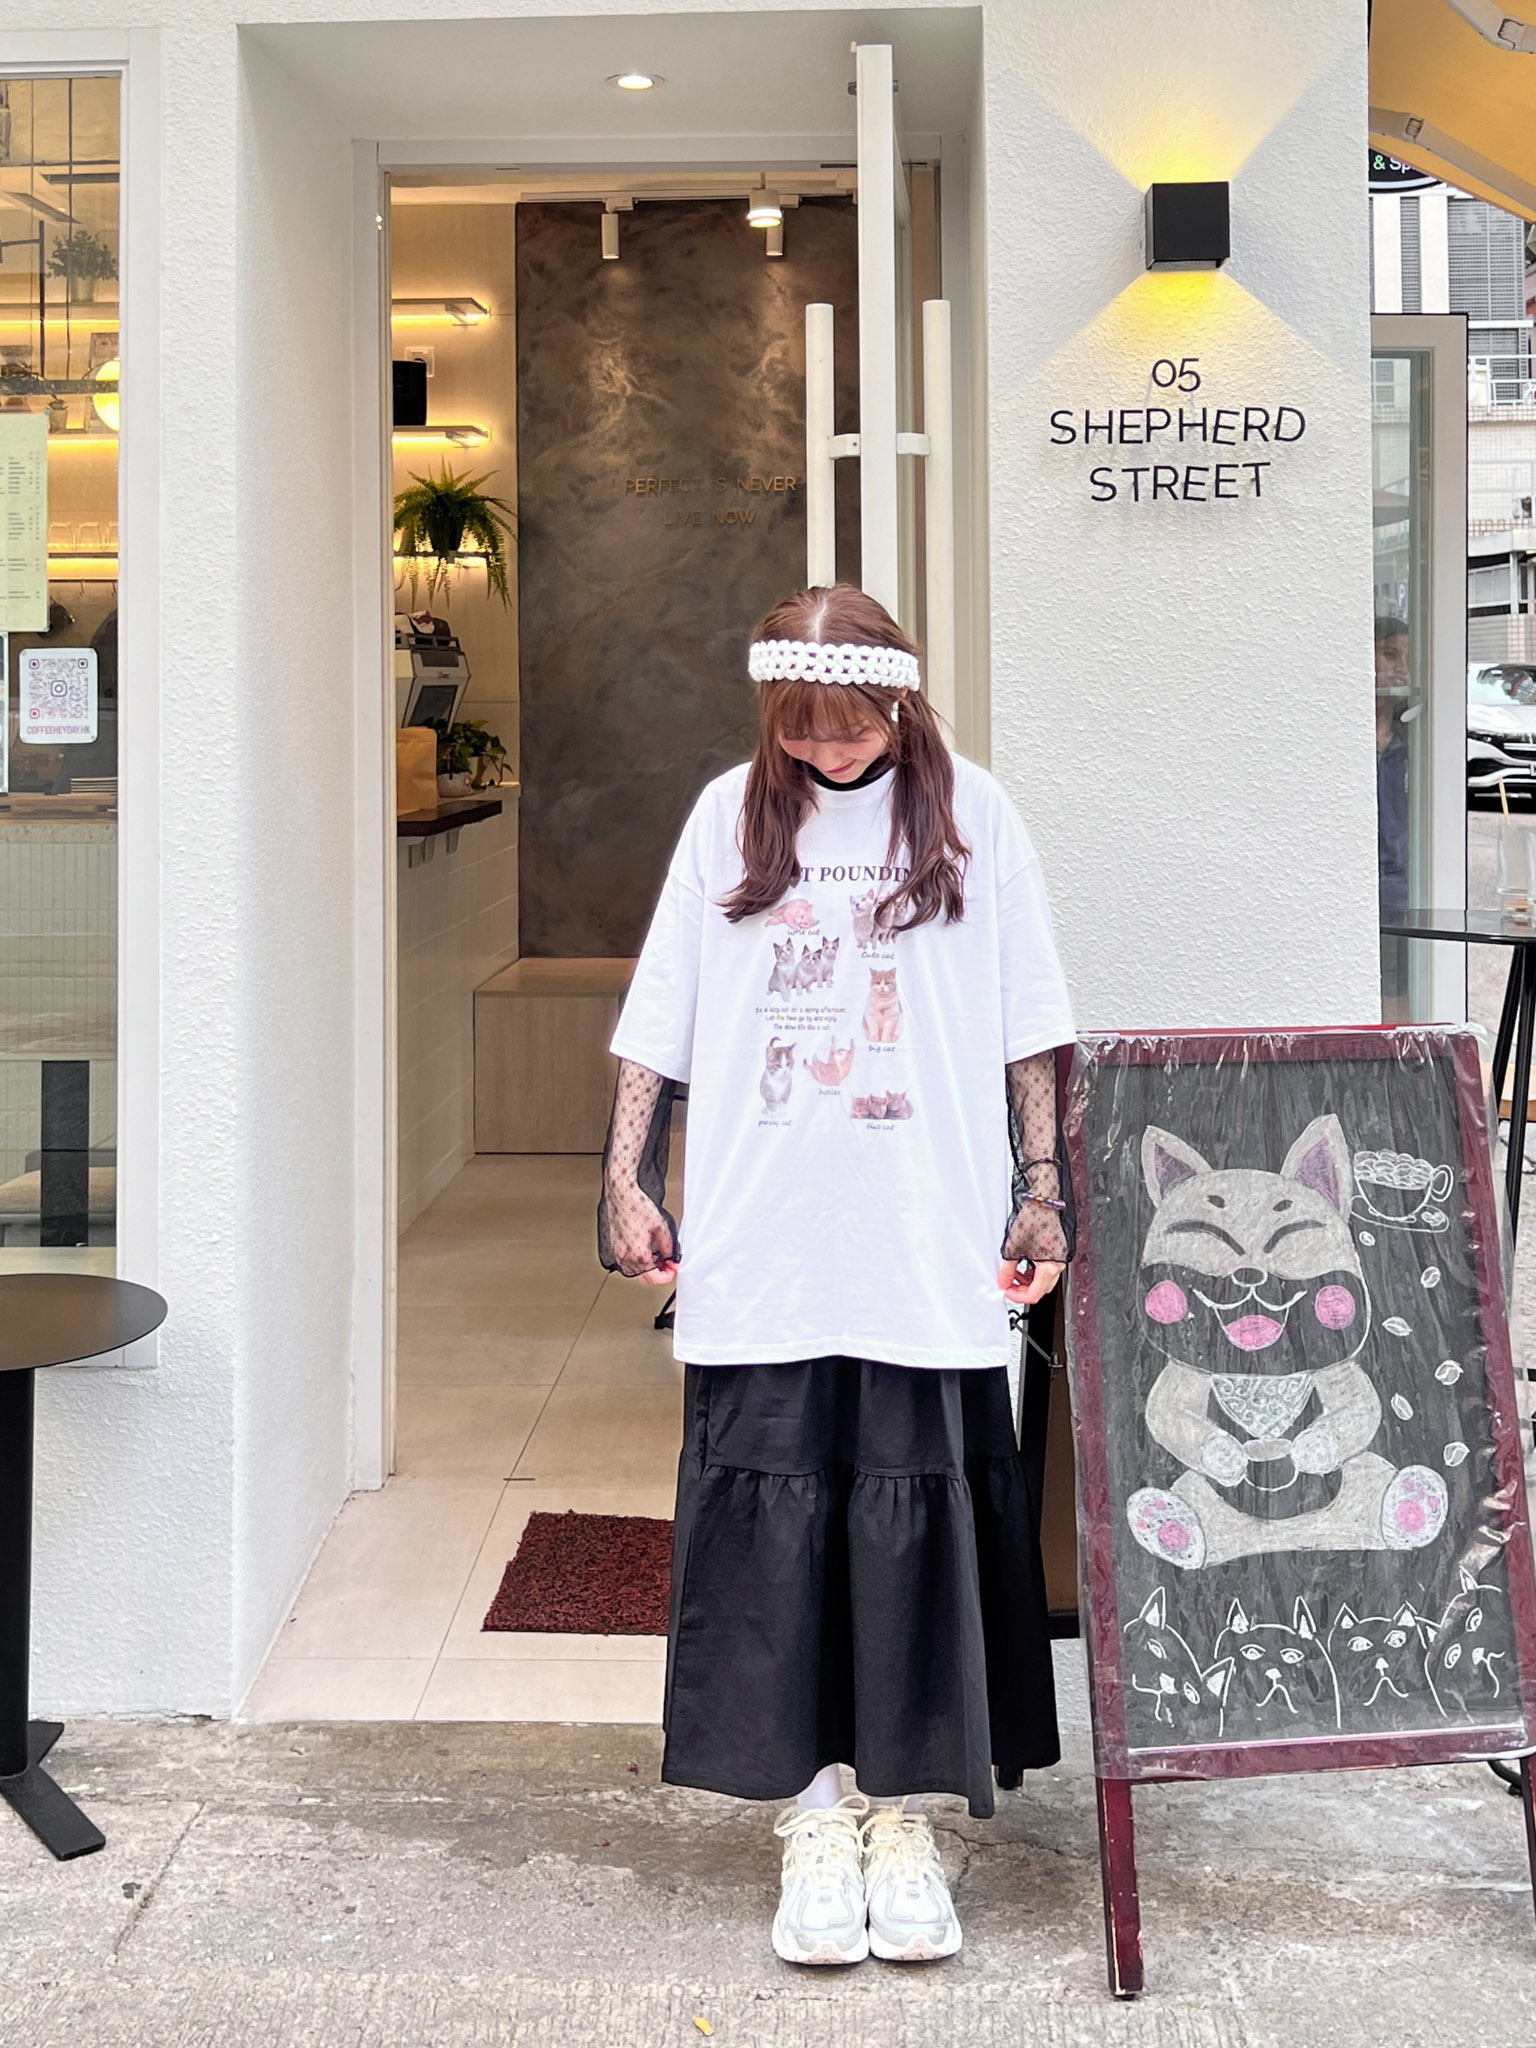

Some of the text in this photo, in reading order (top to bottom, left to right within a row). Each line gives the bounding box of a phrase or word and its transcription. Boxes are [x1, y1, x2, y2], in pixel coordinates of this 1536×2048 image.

[1373, 155, 1411, 174] & Sp
[1152, 357, 1201, 392] 05
[1050, 406, 1306, 446] SHEPHERD
[625, 478, 702, 493] PERFECT
[737, 476, 797, 492] NEVER
[1090, 462, 1271, 502] STREET
[664, 510, 757, 526] LIVE NOW
[881, 951, 896, 960] cat
